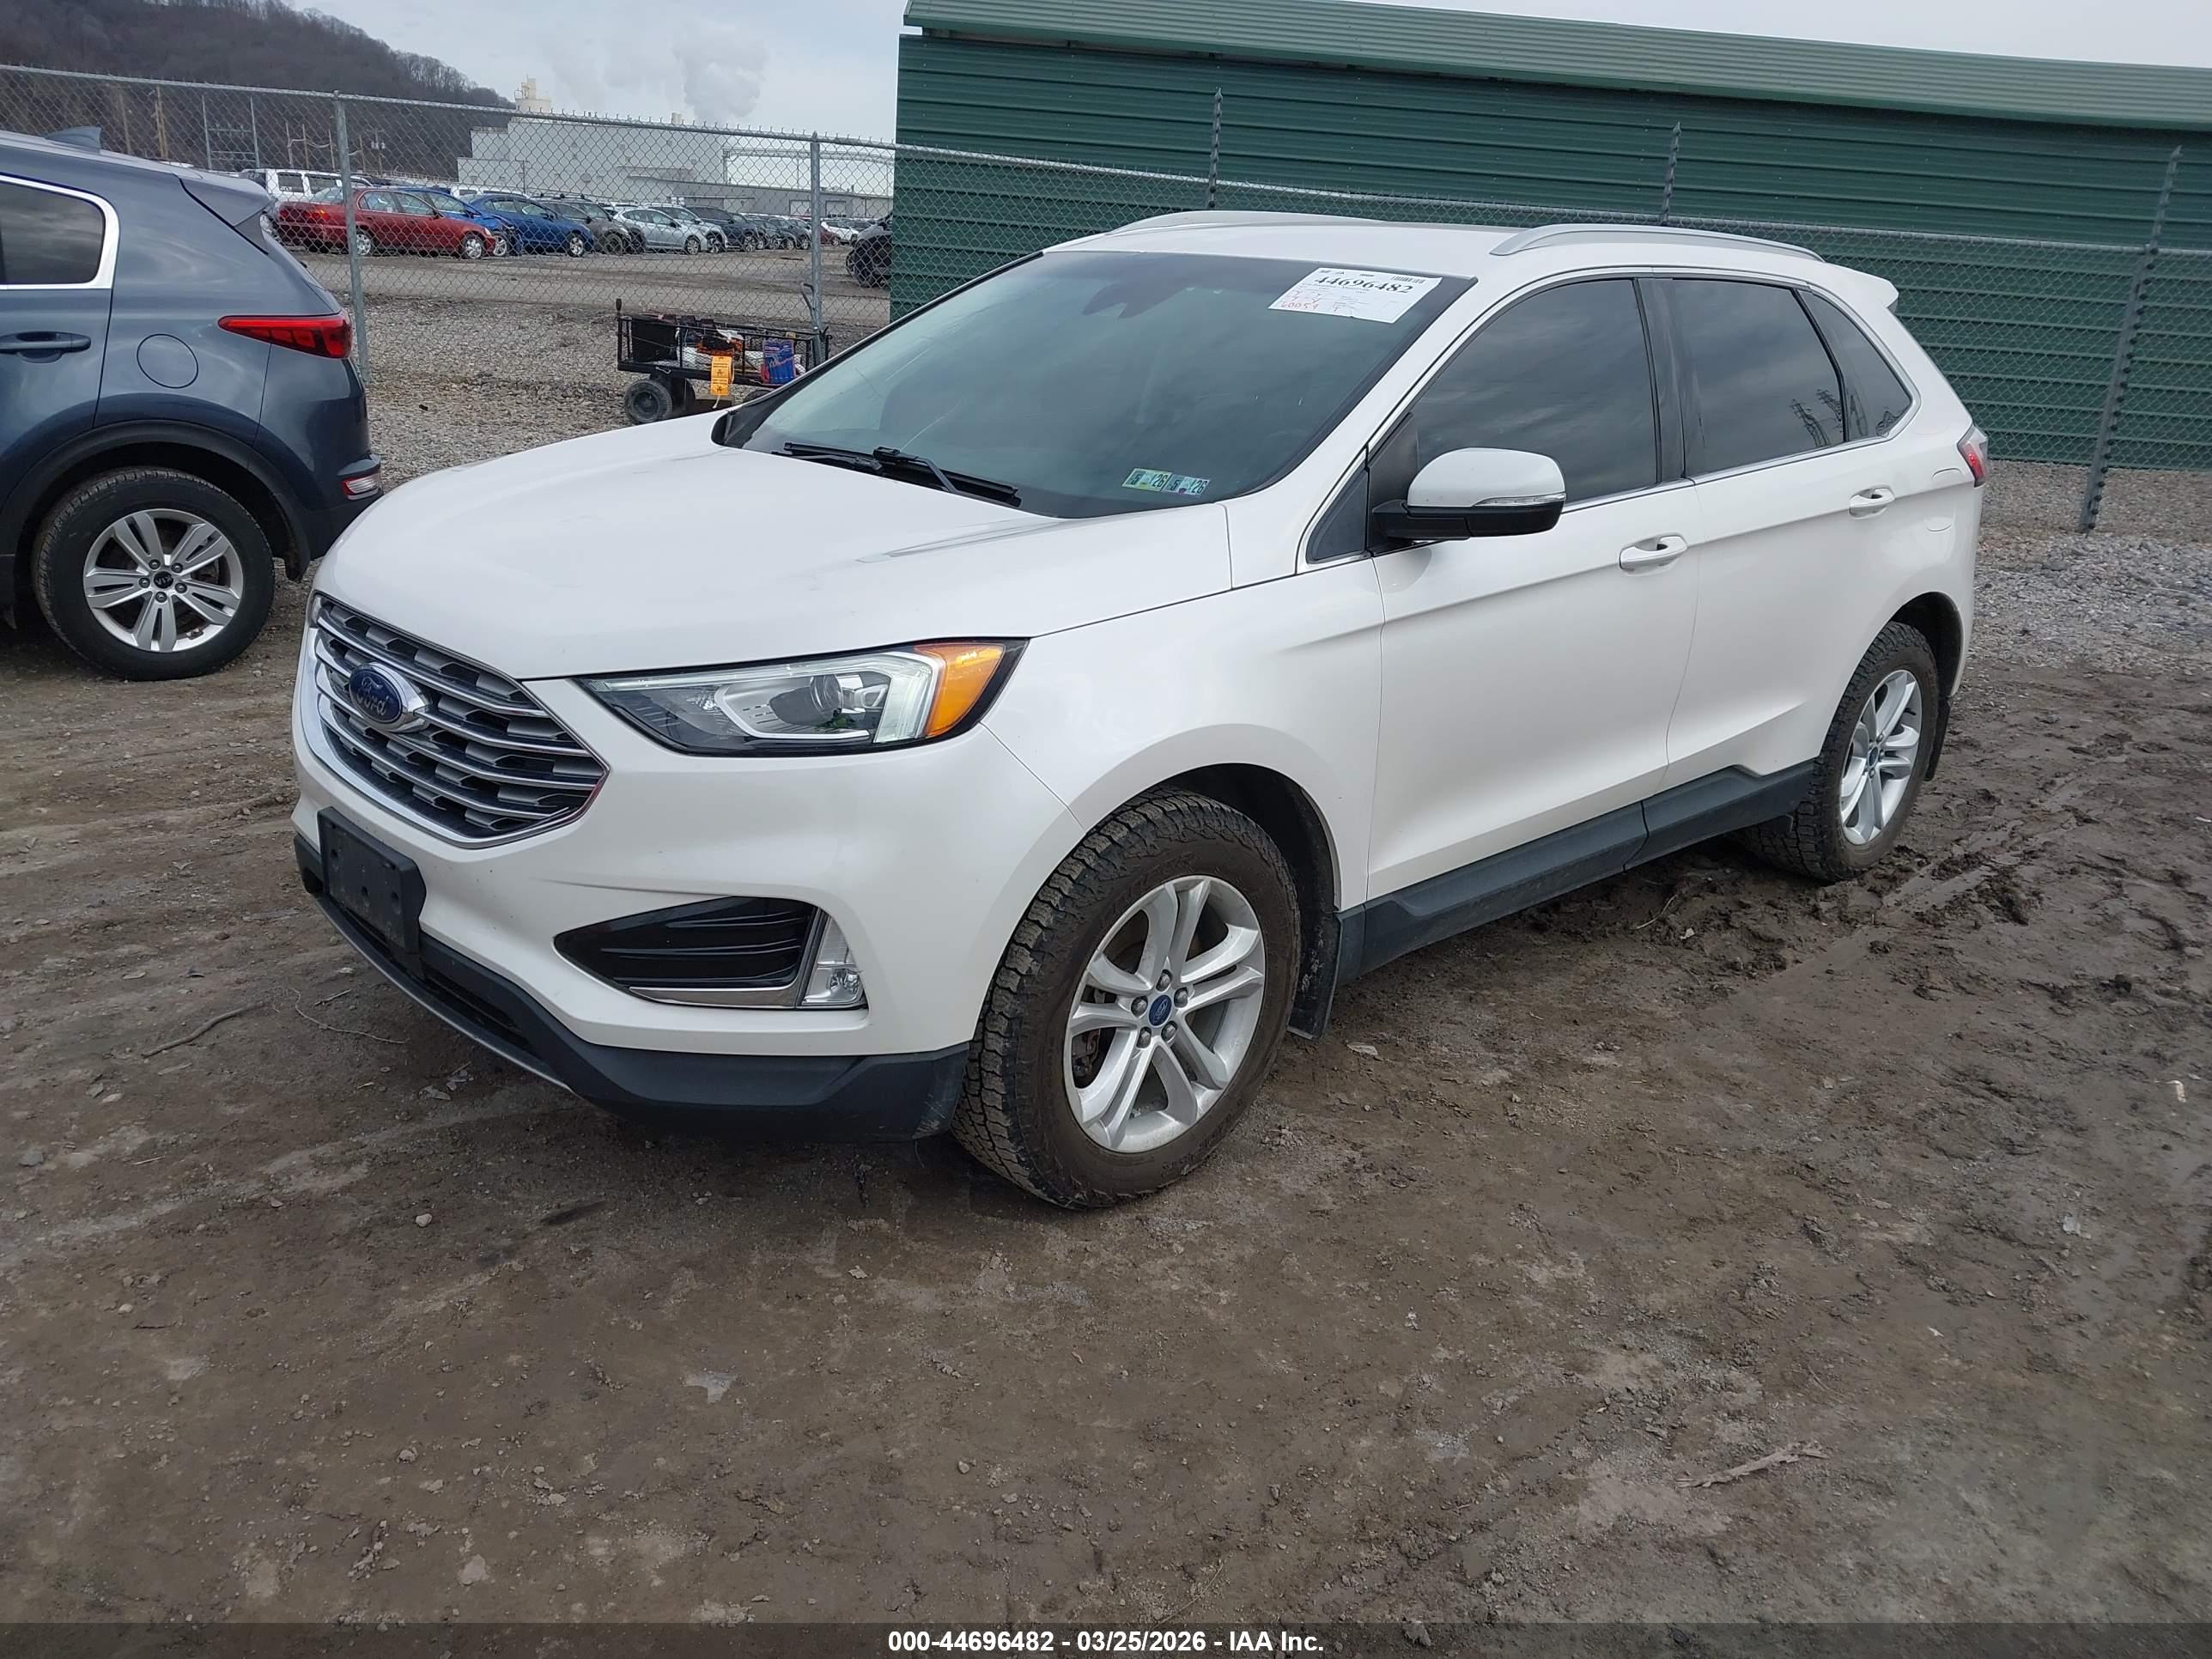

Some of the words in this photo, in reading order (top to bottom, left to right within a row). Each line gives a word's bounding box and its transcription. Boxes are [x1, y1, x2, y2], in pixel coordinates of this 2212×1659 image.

[1315, 276, 1413, 293] 44696482
[1130, 474, 1140, 485] 5
[155, 574, 173, 586] KIA
[356, 676, 390, 715] Ford
